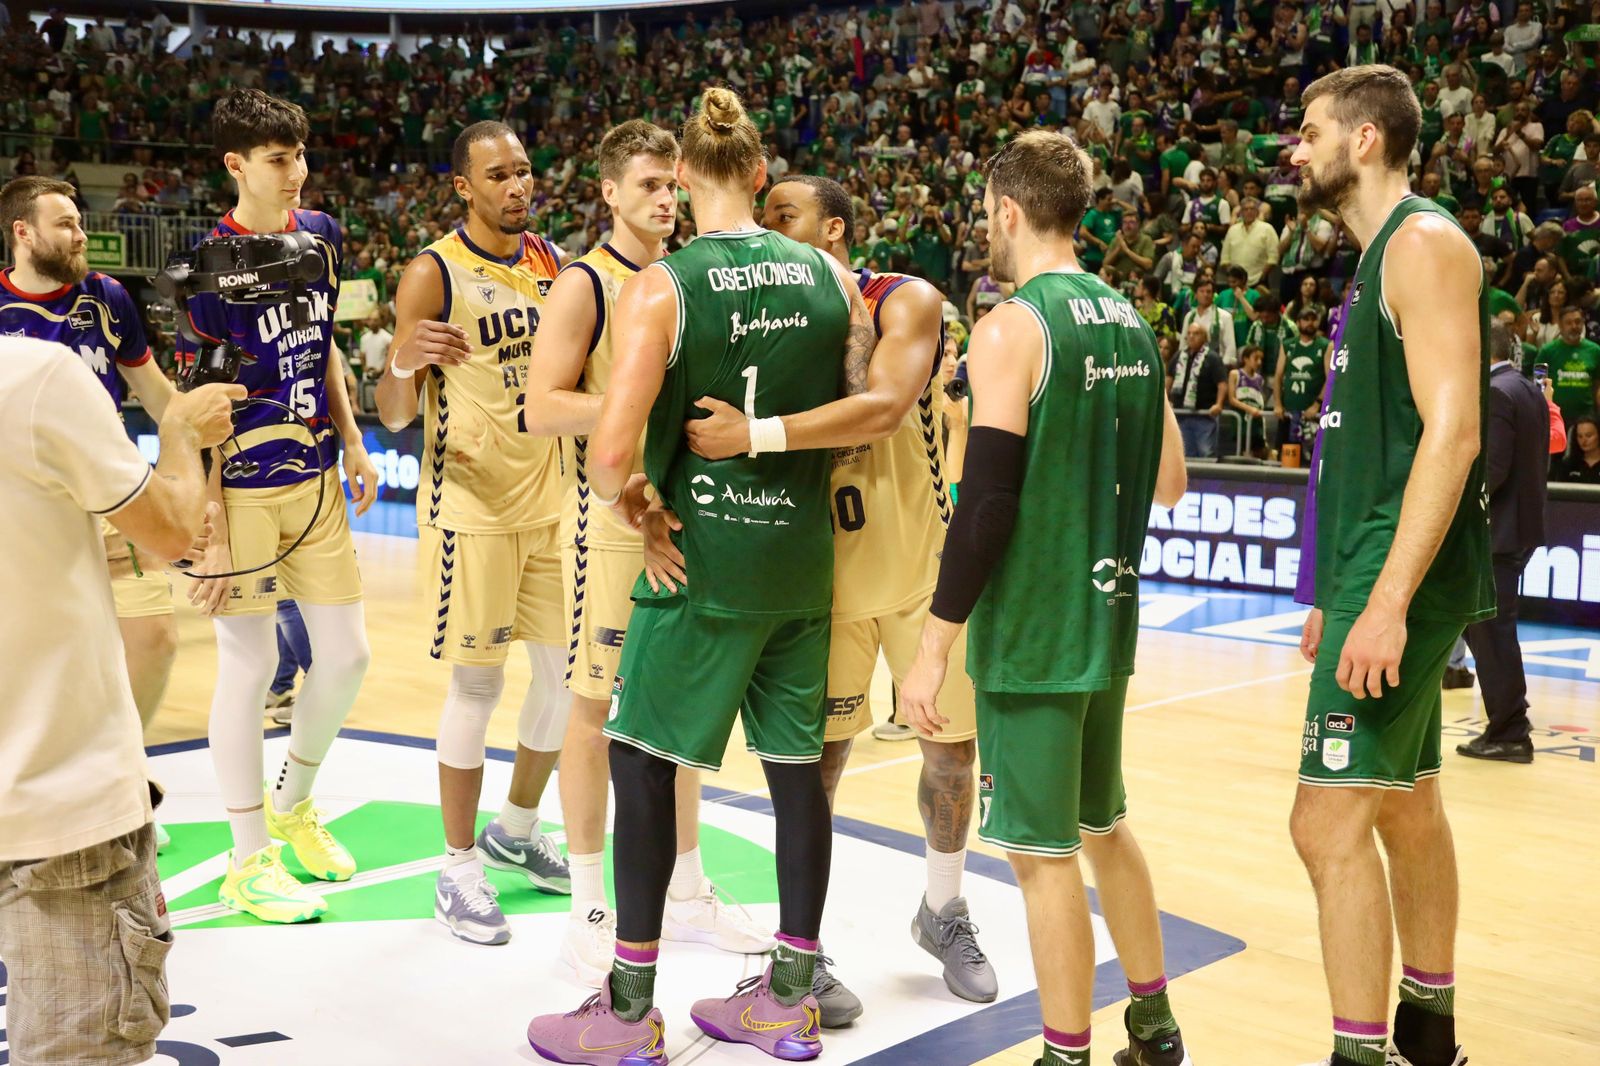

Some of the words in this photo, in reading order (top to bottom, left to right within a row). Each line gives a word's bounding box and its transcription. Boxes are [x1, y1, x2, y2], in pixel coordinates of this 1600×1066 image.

[218, 272, 259, 288] RONIN
[707, 261, 815, 292] OSETKOWSKI
[288, 378, 317, 423] 15
[720, 483, 796, 508] Andalucía
[1328, 720, 1348, 730] acb
